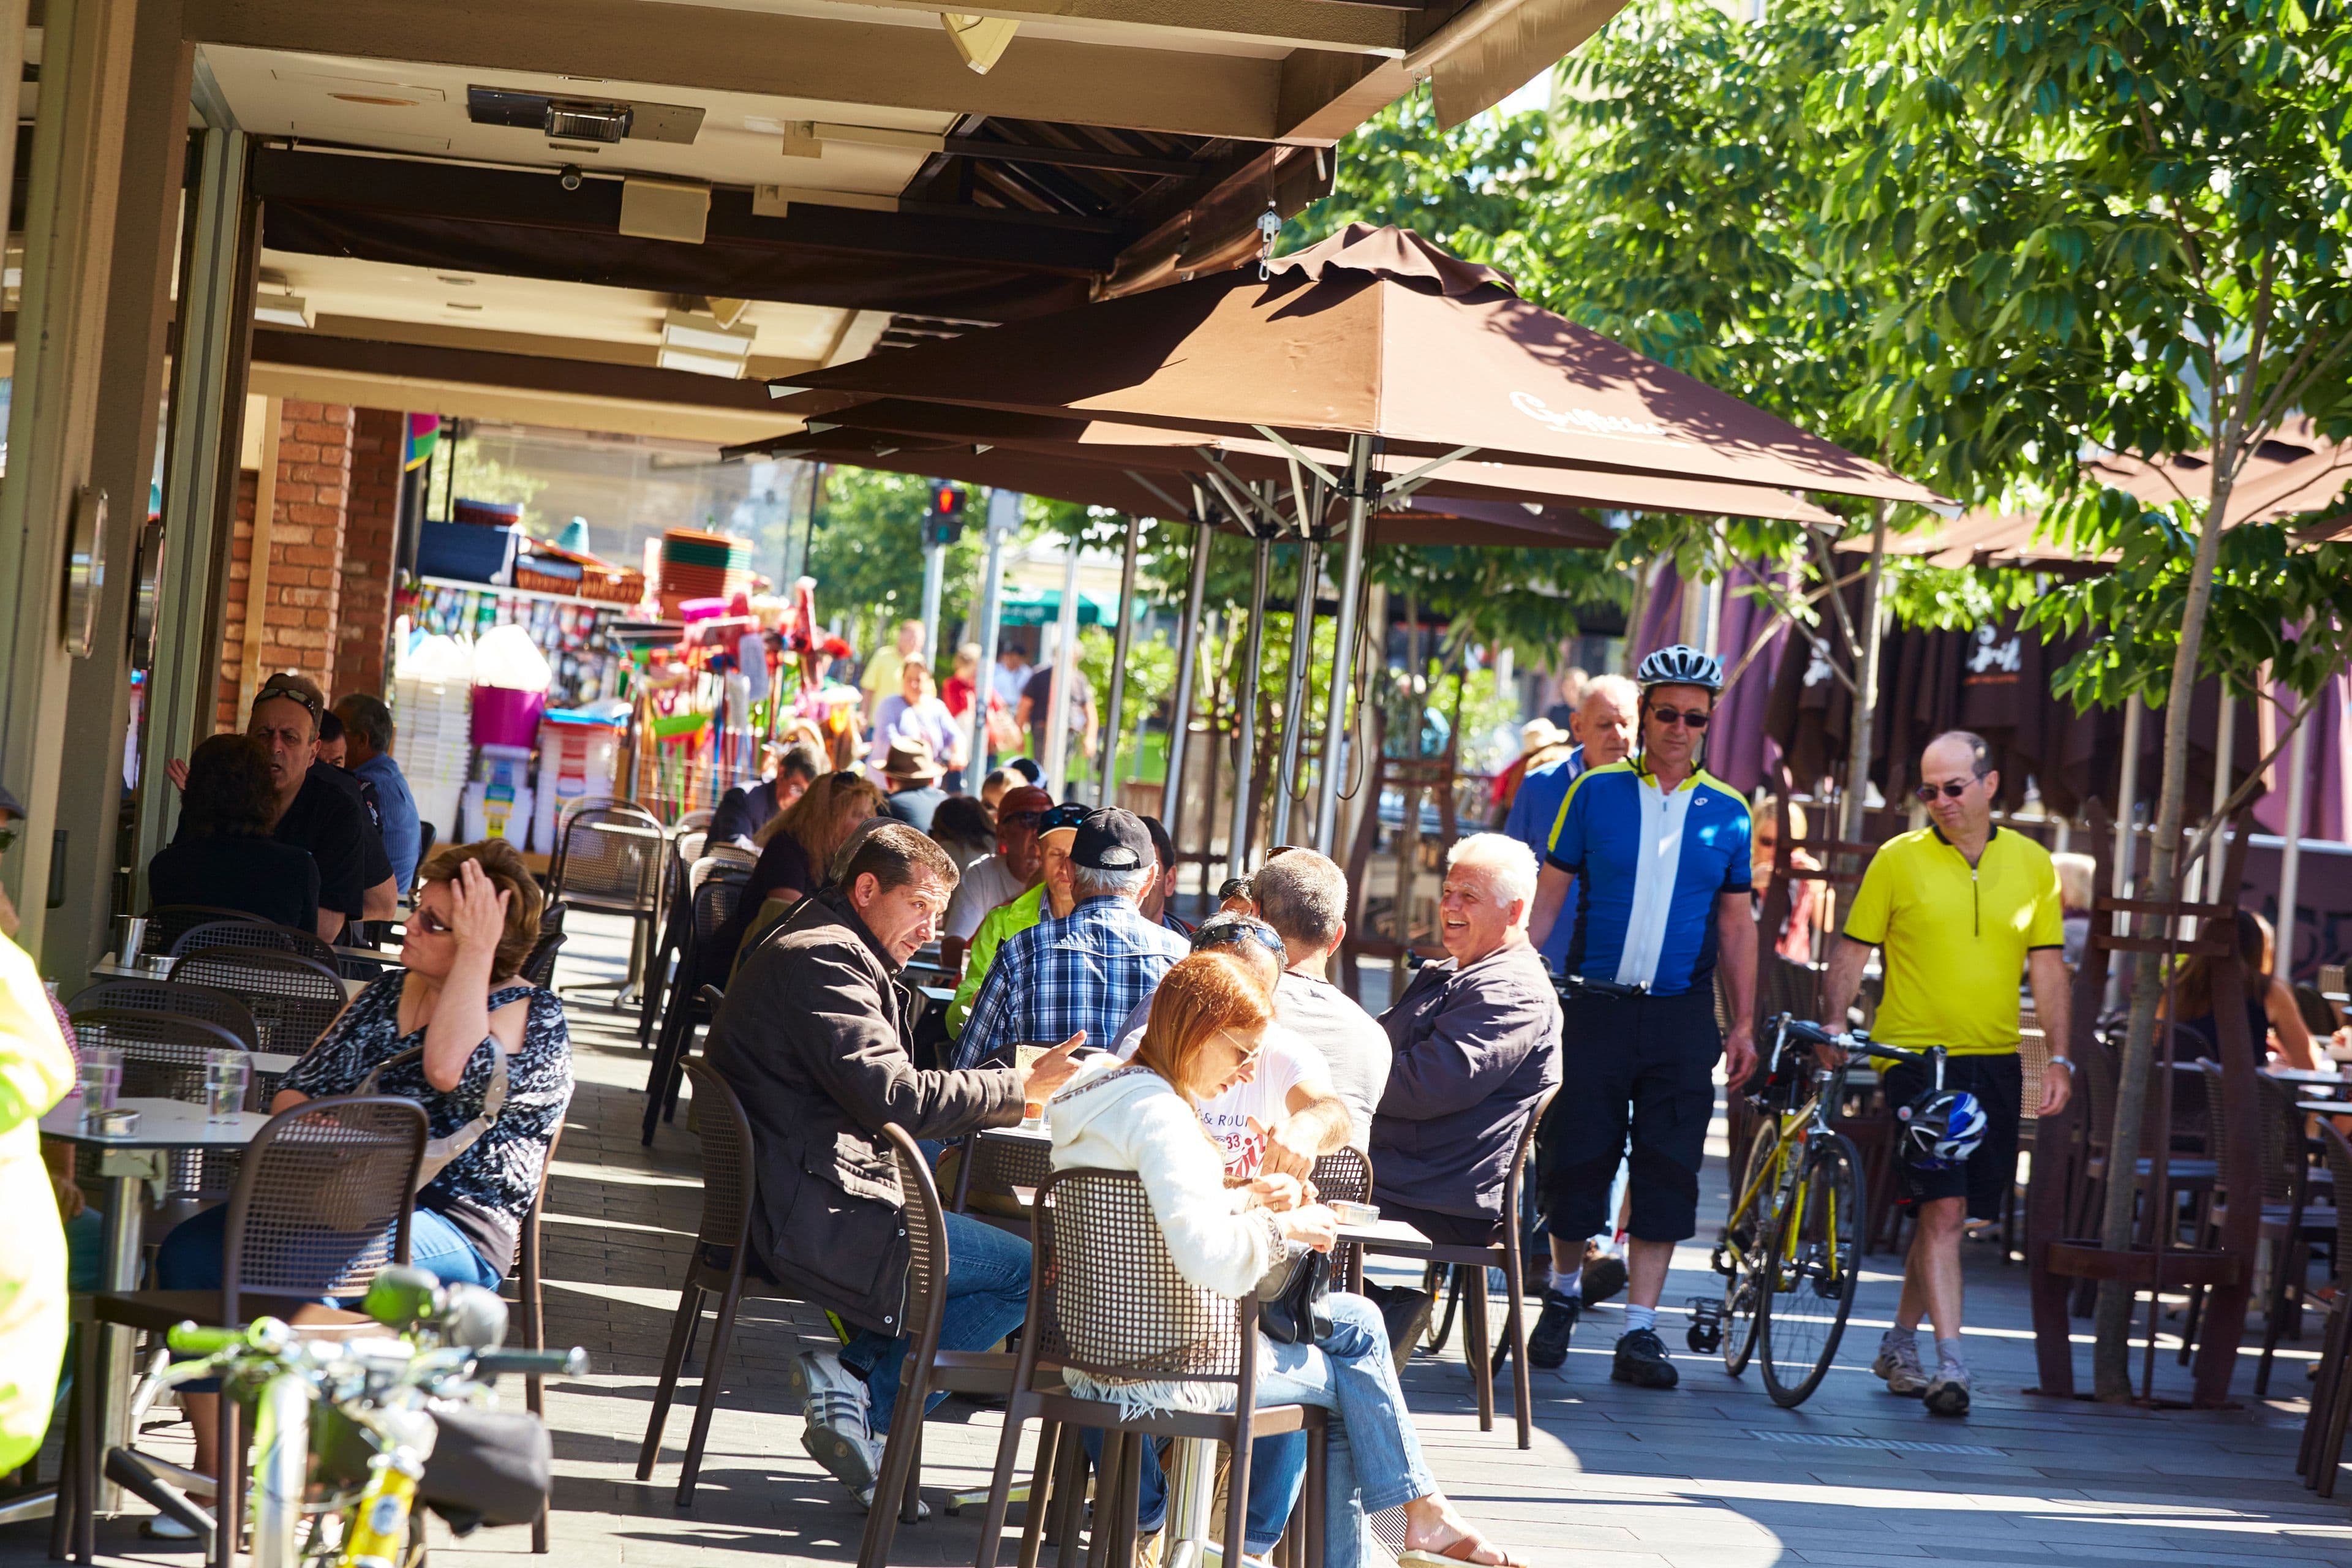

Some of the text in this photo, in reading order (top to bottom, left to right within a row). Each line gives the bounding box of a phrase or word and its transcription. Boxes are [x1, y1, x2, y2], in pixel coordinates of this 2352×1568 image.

[1203, 1112, 1213, 1125] &
[1218, 1114, 1248, 1127] ROU
[1226, 1134, 1240, 1150] 33
